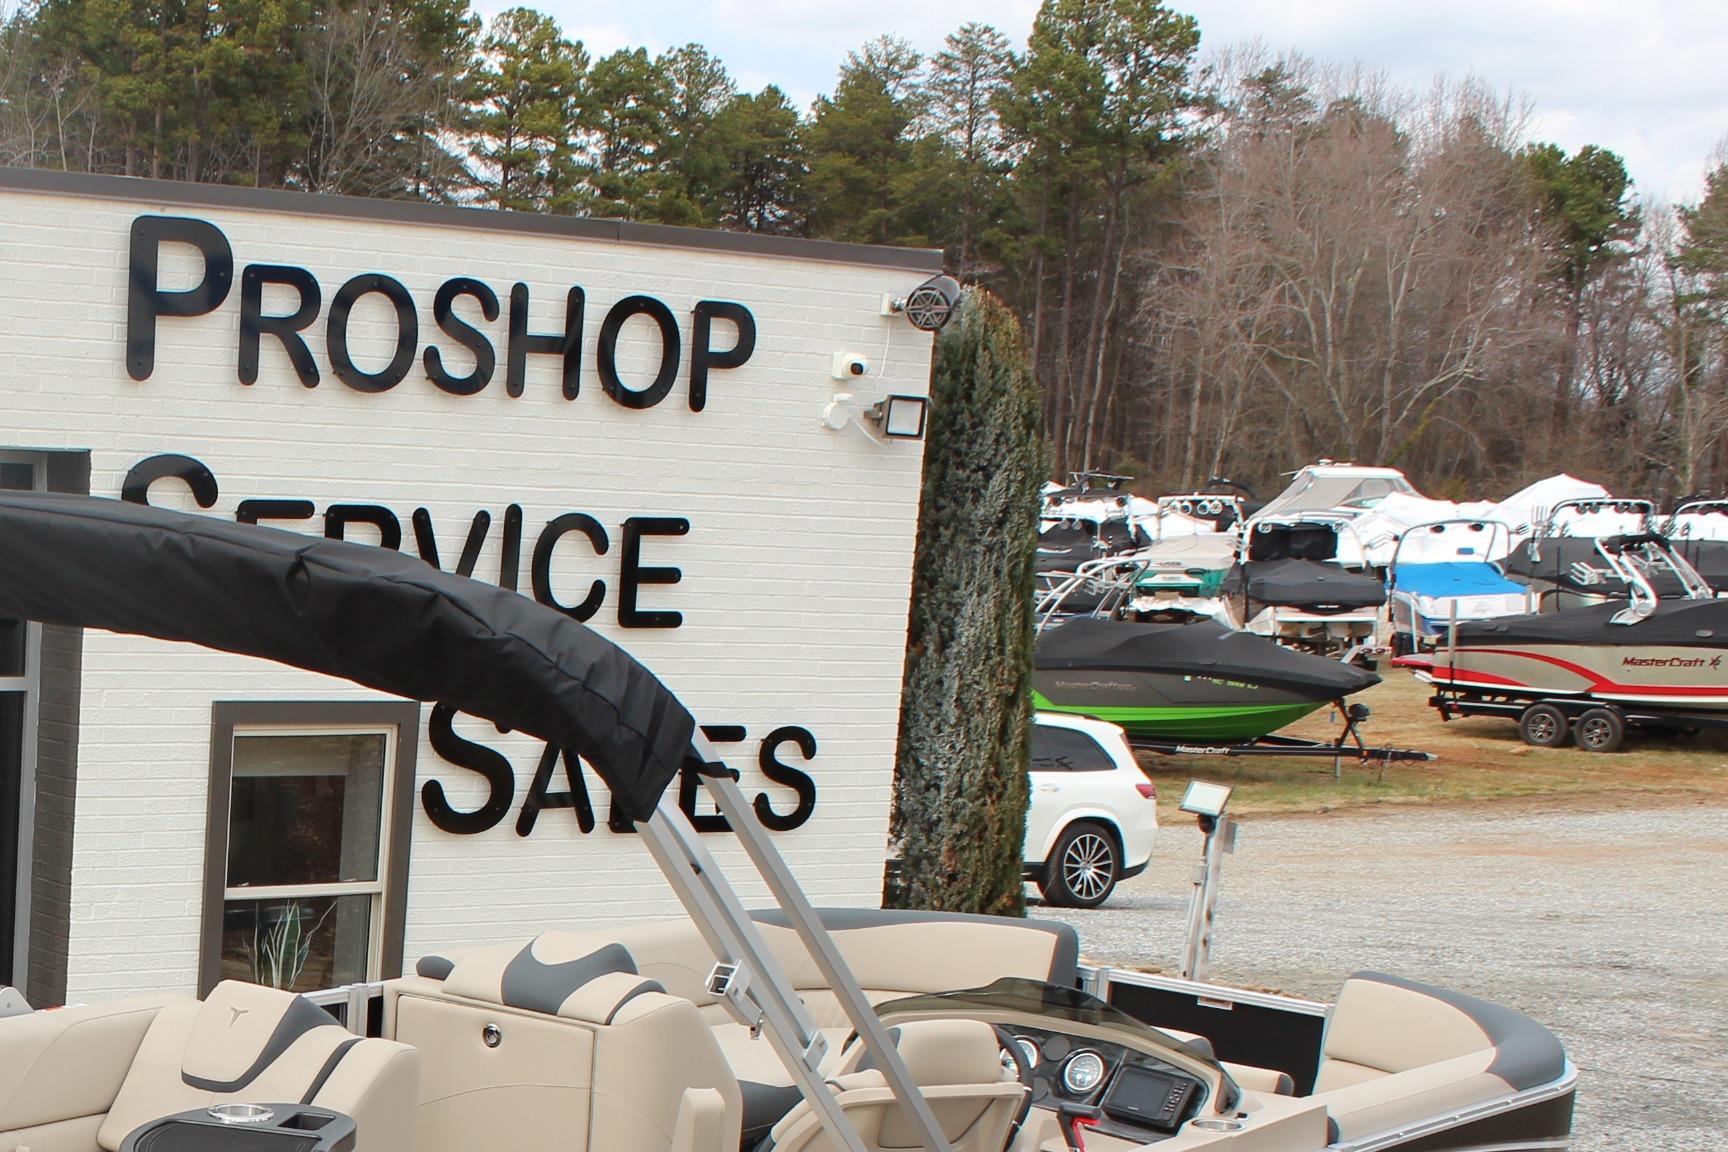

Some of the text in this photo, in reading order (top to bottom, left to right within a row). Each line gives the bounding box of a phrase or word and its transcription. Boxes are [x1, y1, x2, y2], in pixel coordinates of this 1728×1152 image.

[126, 215, 757, 413] PROSHOP
[1622, 656, 1705, 667] MasterCraft
[1176, 745, 1229, 754] MasterCraft
